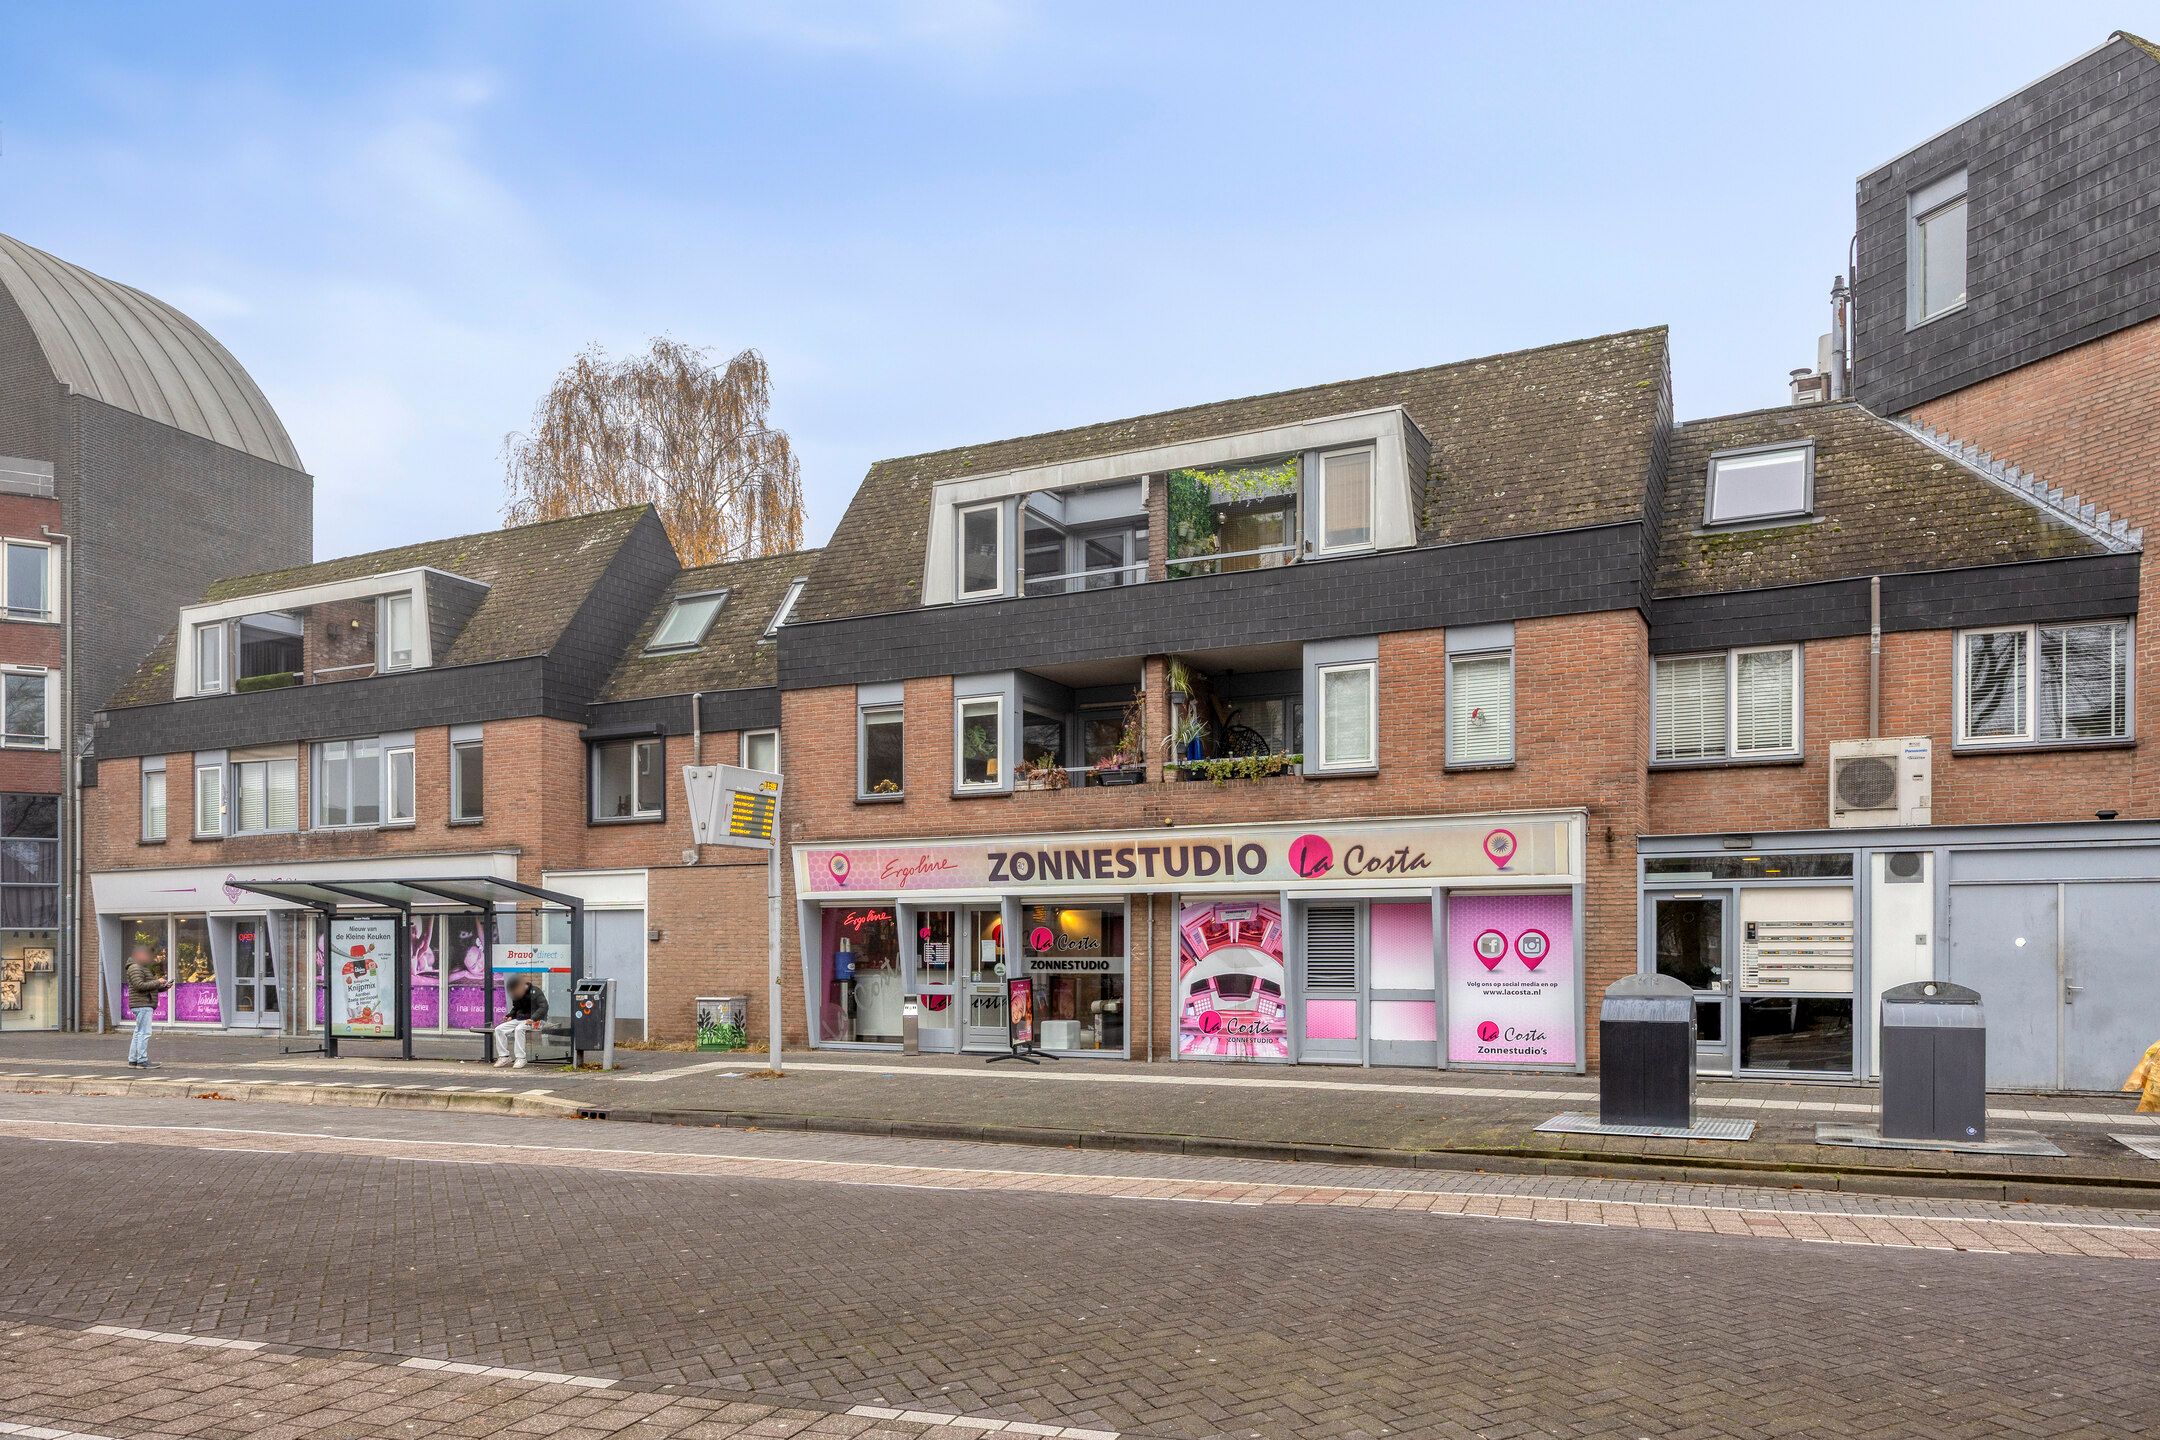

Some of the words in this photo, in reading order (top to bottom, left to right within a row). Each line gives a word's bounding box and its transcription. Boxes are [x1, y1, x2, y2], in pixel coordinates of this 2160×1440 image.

[988, 843, 1268, 881] ZONNESTUDIO
[1300, 846, 1335, 878] La
[1344, 845, 1431, 876] Costa
[881, 855, 958, 887] Ergoline
[844, 910, 891, 930] Ergoline
[1036, 934, 1053, 950] La
[1058, 934, 1099, 951] Costa
[507, 951, 533, 959] Bravo
[537, 951, 557, 959] direct
[1031, 960, 1109, 970] ZONNESTUDIO
[347, 982, 376, 992] Knijpmix
[1483, 988, 1541, 996] www.lacosta.nl
[1204, 1017, 1222, 1034] La
[1227, 1017, 1271, 1035] Costa
[1482, 1026, 1499, 1041] La
[1504, 1027, 1547, 1042] Costa
[1227, 1036, 1274, 1044] ZONNESTUDIO
[1478, 1046, 1547, 1055] Zonnestudio's
